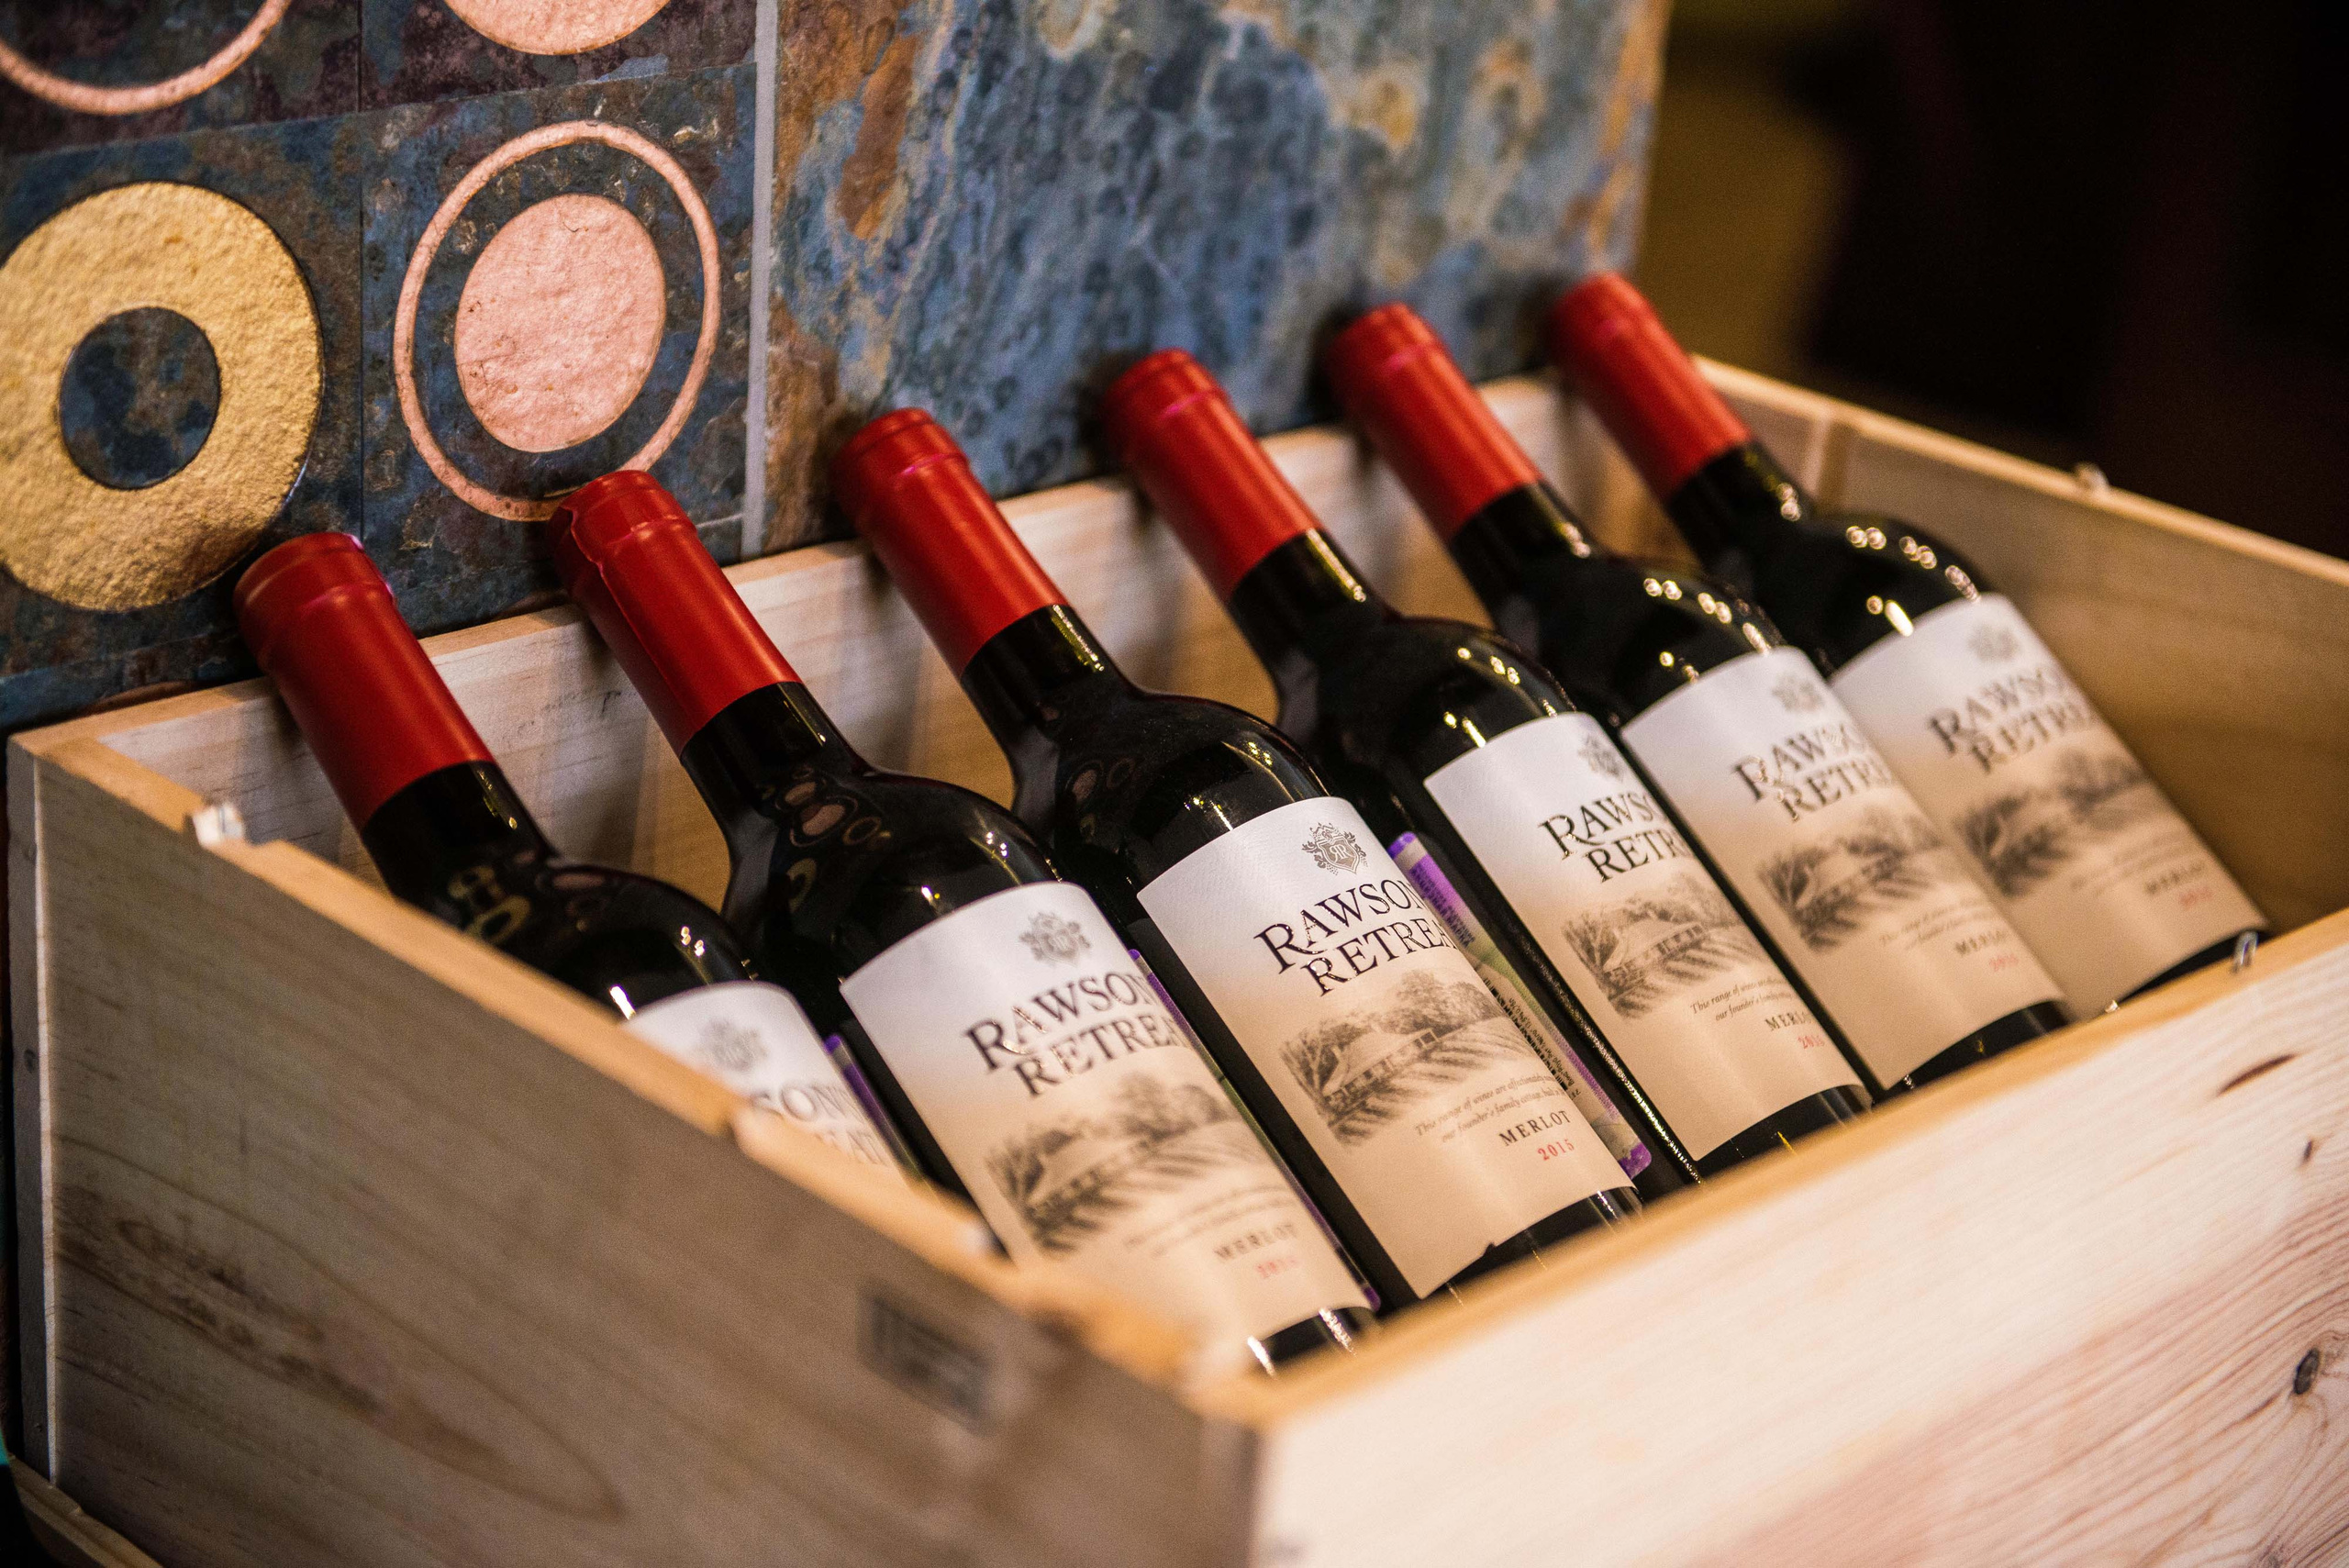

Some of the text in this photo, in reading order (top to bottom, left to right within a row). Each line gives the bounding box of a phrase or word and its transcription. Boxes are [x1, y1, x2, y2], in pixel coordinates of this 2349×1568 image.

[1300, 918, 1457, 996] RETREA
[1014, 1013, 1187, 1095] RETREA
[1498, 1110, 1572, 1147] MERLOT
[1537, 1139, 1575, 1162] 2015
